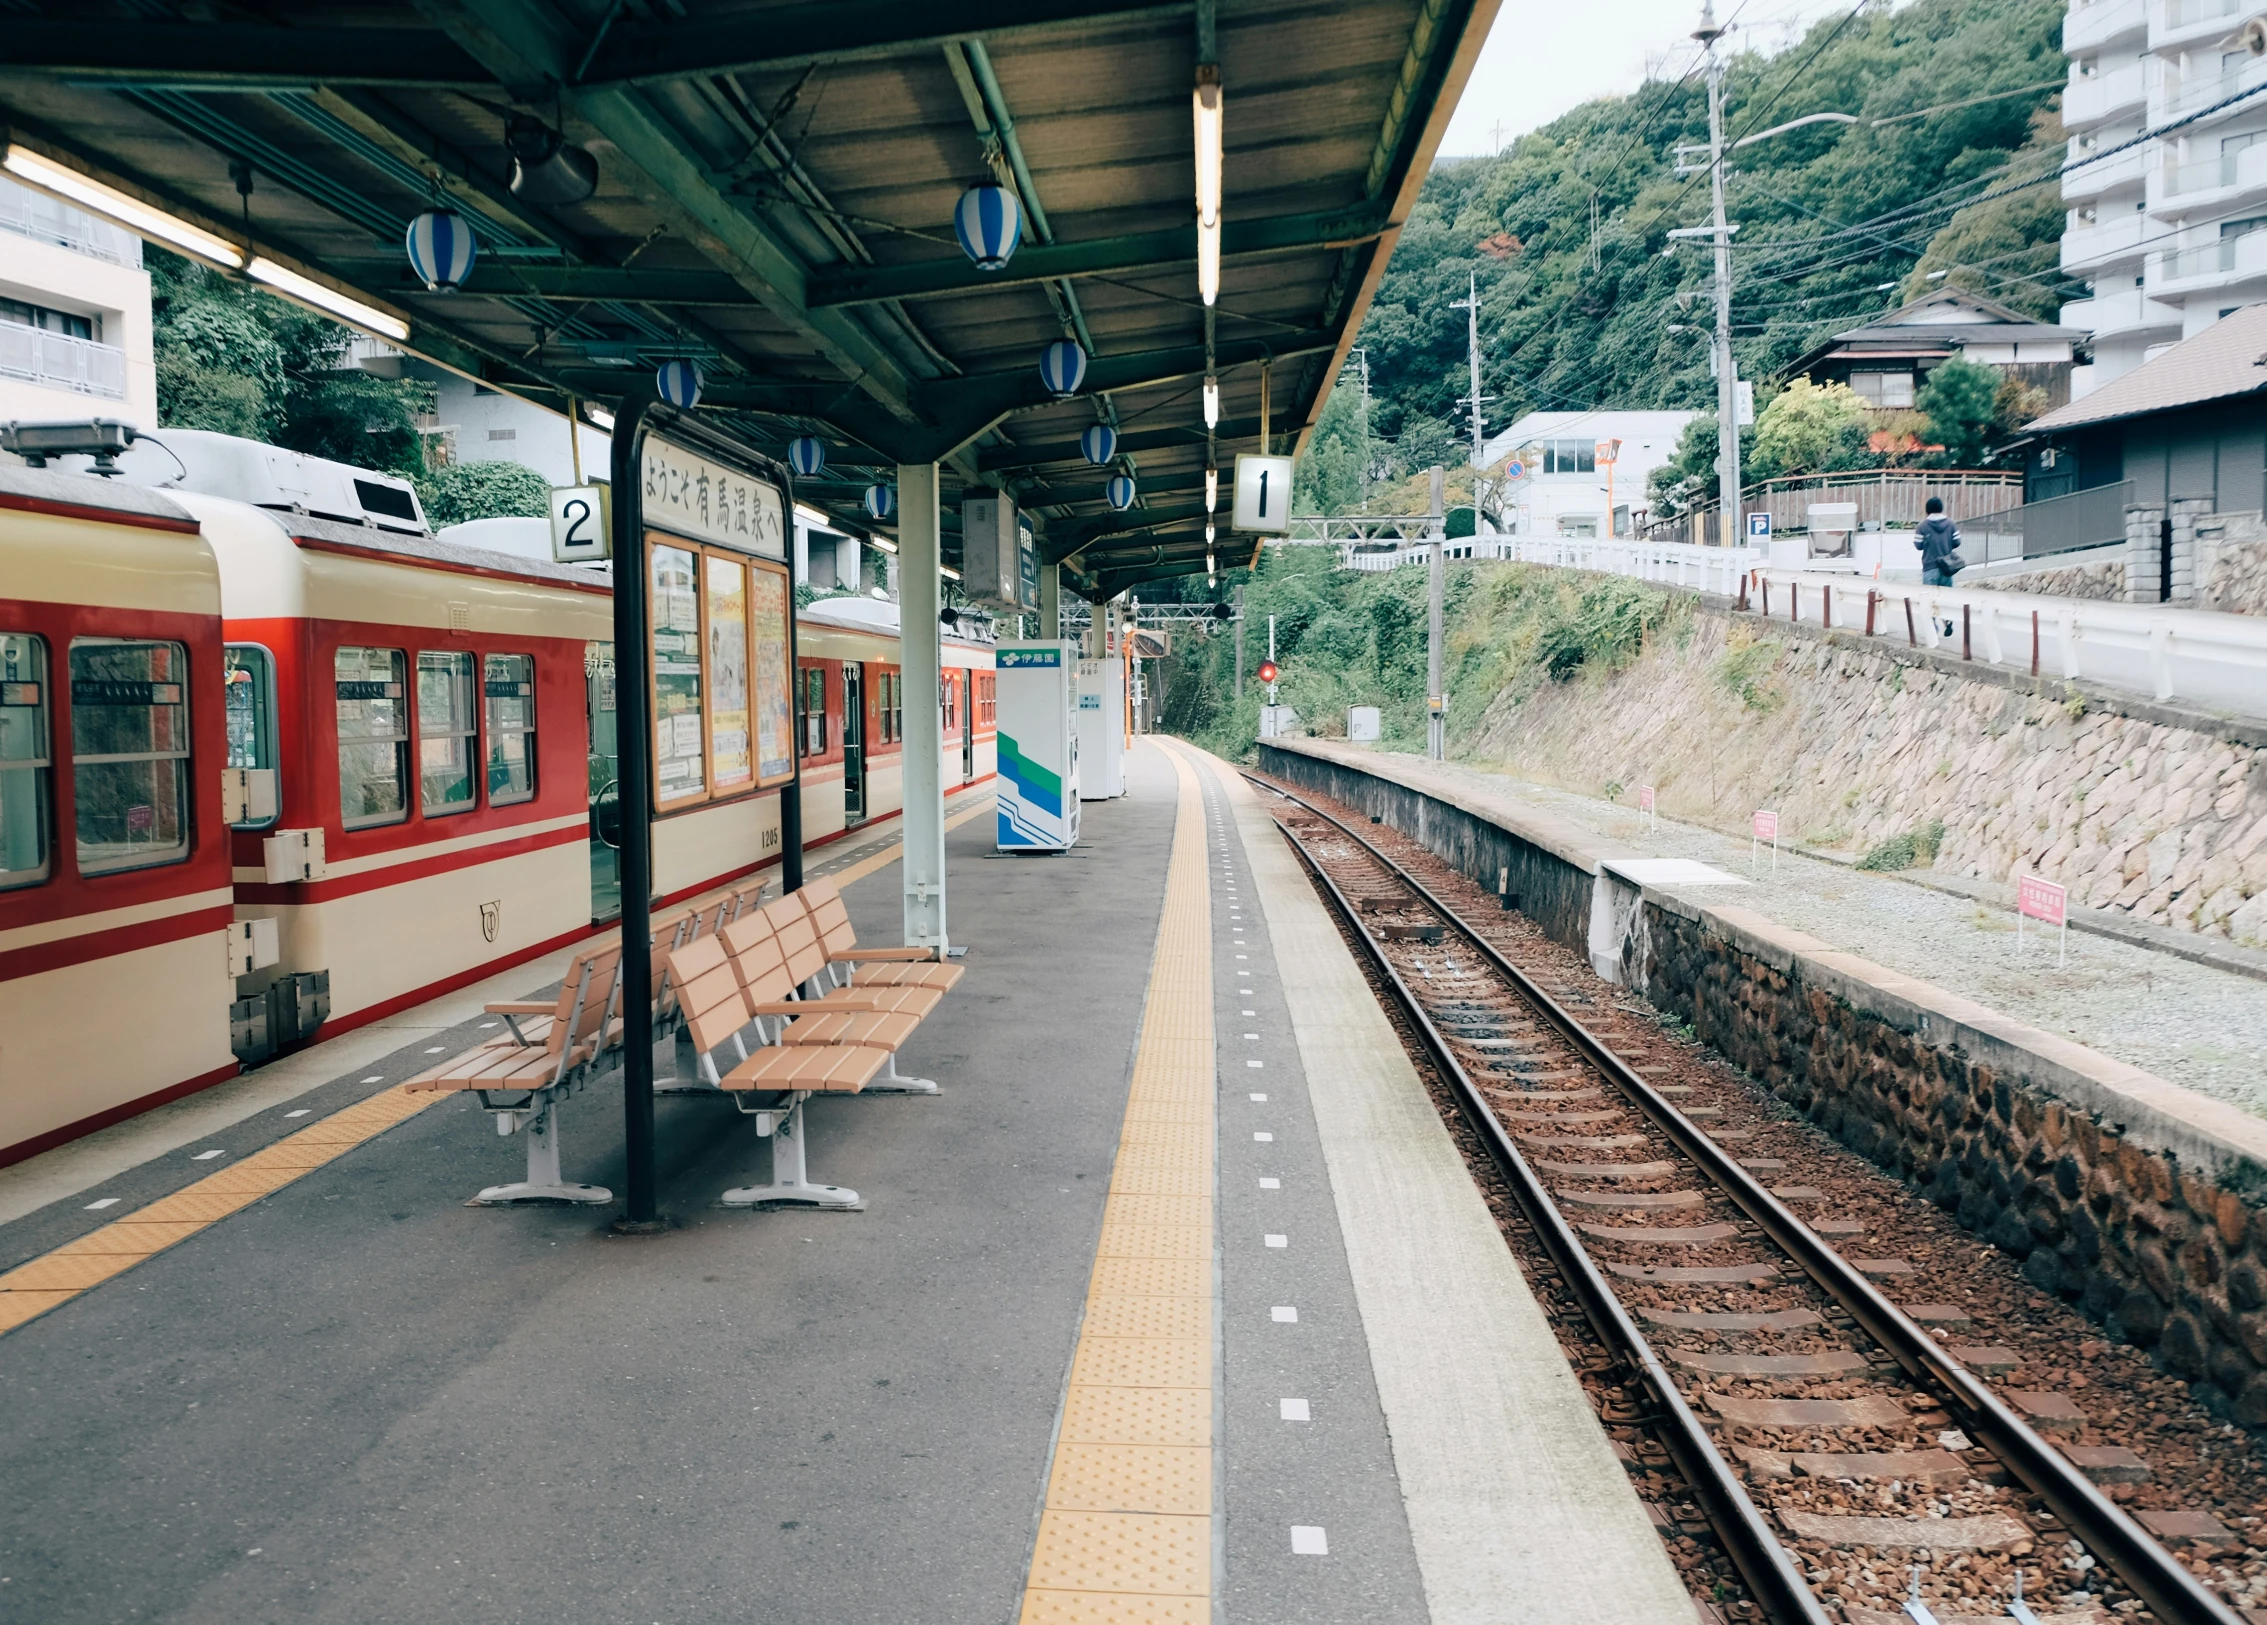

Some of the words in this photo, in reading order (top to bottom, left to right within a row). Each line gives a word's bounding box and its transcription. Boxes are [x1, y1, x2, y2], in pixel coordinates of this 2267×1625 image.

[646, 456, 779, 542] ようこそ有馬温泉へ
[1259, 470, 1268, 517] 1
[563, 499, 593, 547] 2
[1755, 521, 1767, 535] P
[1021, 653, 1055, 664] 伊藤園
[762, 827, 778, 849] 1205
